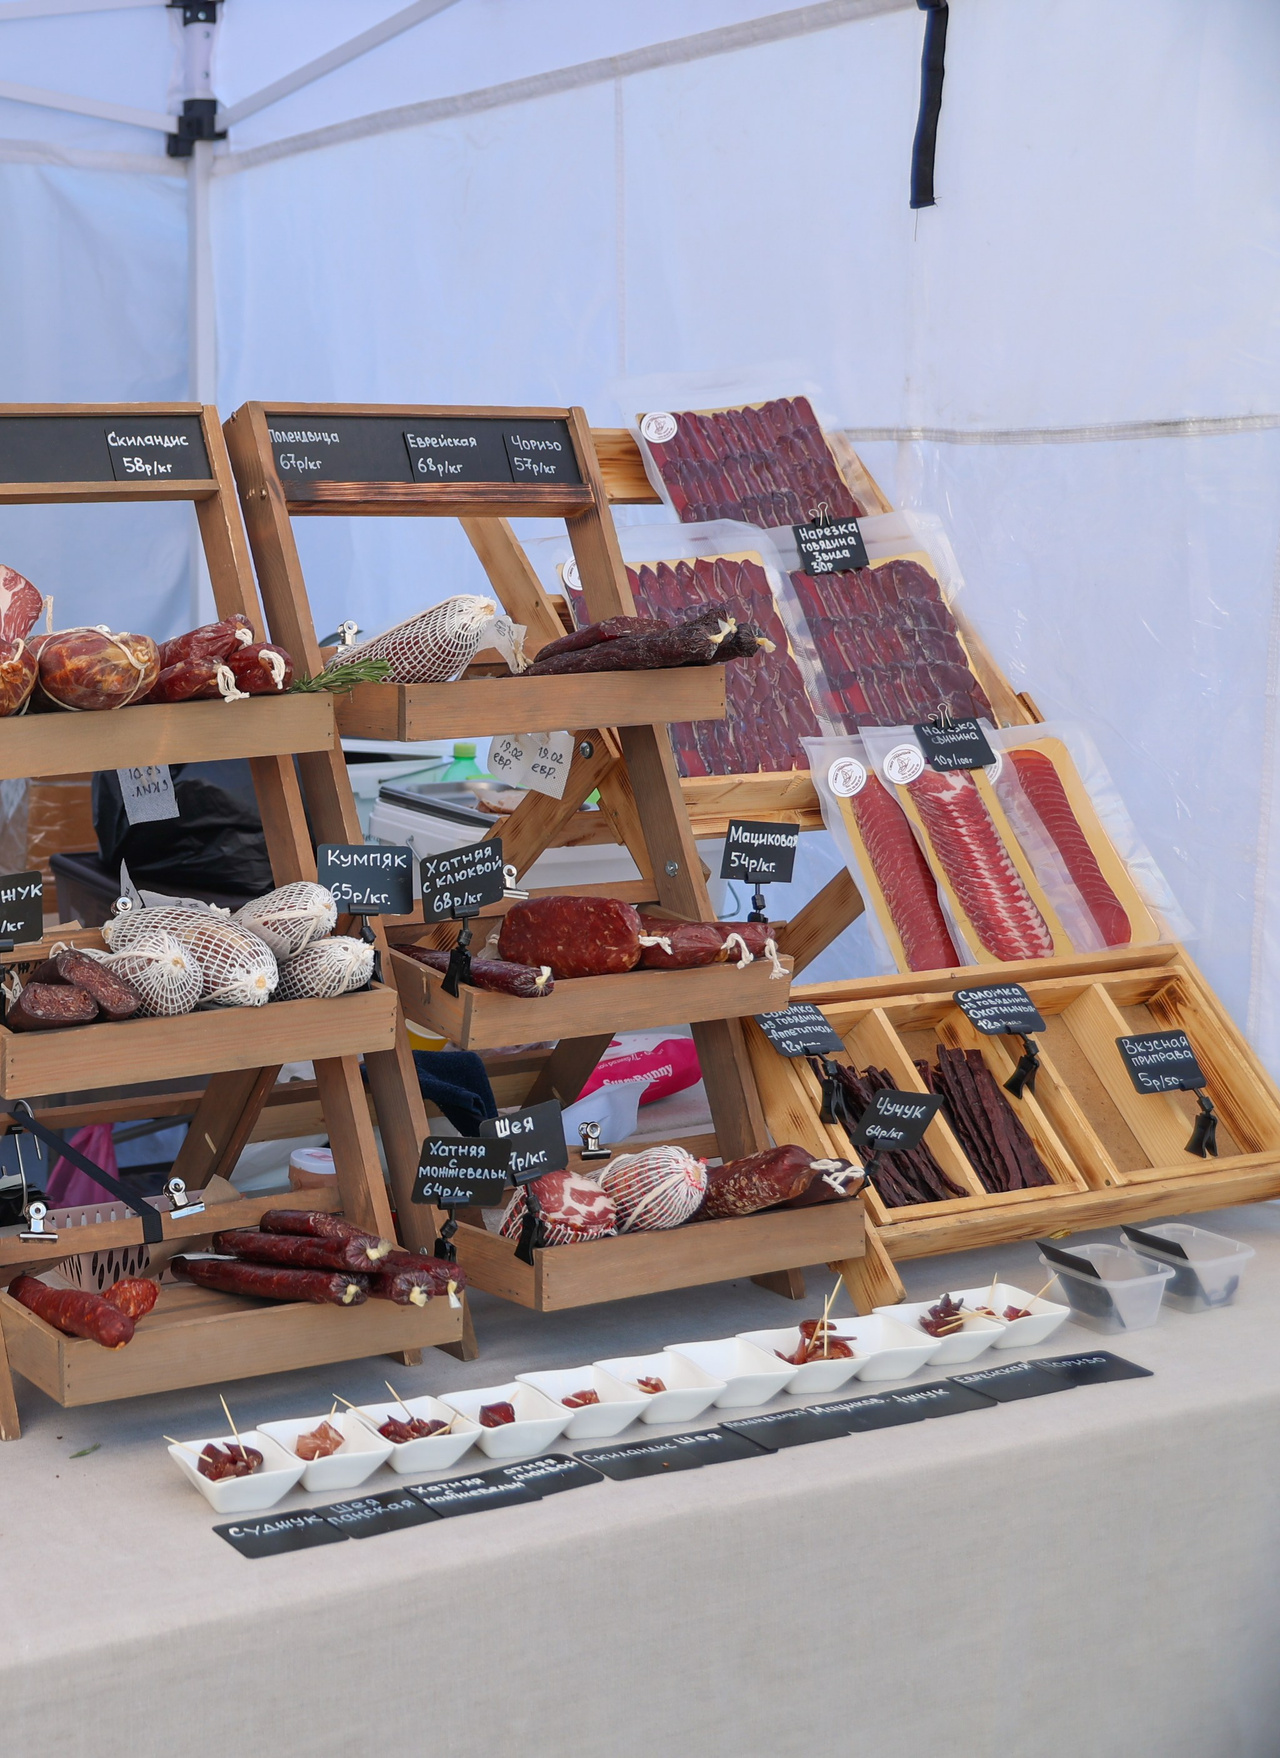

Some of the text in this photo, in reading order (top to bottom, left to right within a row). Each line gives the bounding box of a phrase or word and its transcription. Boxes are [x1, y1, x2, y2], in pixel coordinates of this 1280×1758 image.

[107, 432, 189, 448] Скиландис
[407, 433, 478, 448] Еврейская
[511, 434, 562, 451] Чоризо
[122, 457, 173, 477] 58р/кг
[280, 453, 322, 473] 67р/кг
[418, 458, 464, 477] 68р/кг
[514, 457, 556, 476] 57р/кг
[799, 522, 858, 541] Нарезка
[801, 536, 856, 552] говядина
[729, 826, 798, 848] Мациковая
[327, 850, 407, 868] Кумпяк
[426, 847, 492, 876] Хатняя
[436, 856, 502, 888] клюквой
[433, 892, 483, 912] 68р/кг
[957, 988, 1022, 1002] Соломка
[775, 1014, 825, 1026] говядины
[1122, 1036, 1189, 1055] Вкусная
[1131, 1050, 1193, 1067] приправа
[1137, 1072, 1183, 1091] 5р/50
[495, 1116, 534, 1138] Шея
[865, 1124, 904, 1139] 64р/кг
[429, 1140, 486, 1158] Хатняя
[448, 1158, 457, 1168] с
[509, 1150, 547, 1171] 7р/кг.
[418, 1166, 508, 1180] можжевельн.
[675, 1432, 723, 1445] Шея
[582, 1442, 678, 1463] Скиландис
[503, 1458, 558, 1475] атняя
[410, 1477, 485, 1494] Хатняя
[326, 1499, 416, 1526] панская
[329, 1498, 380, 1515] Шея
